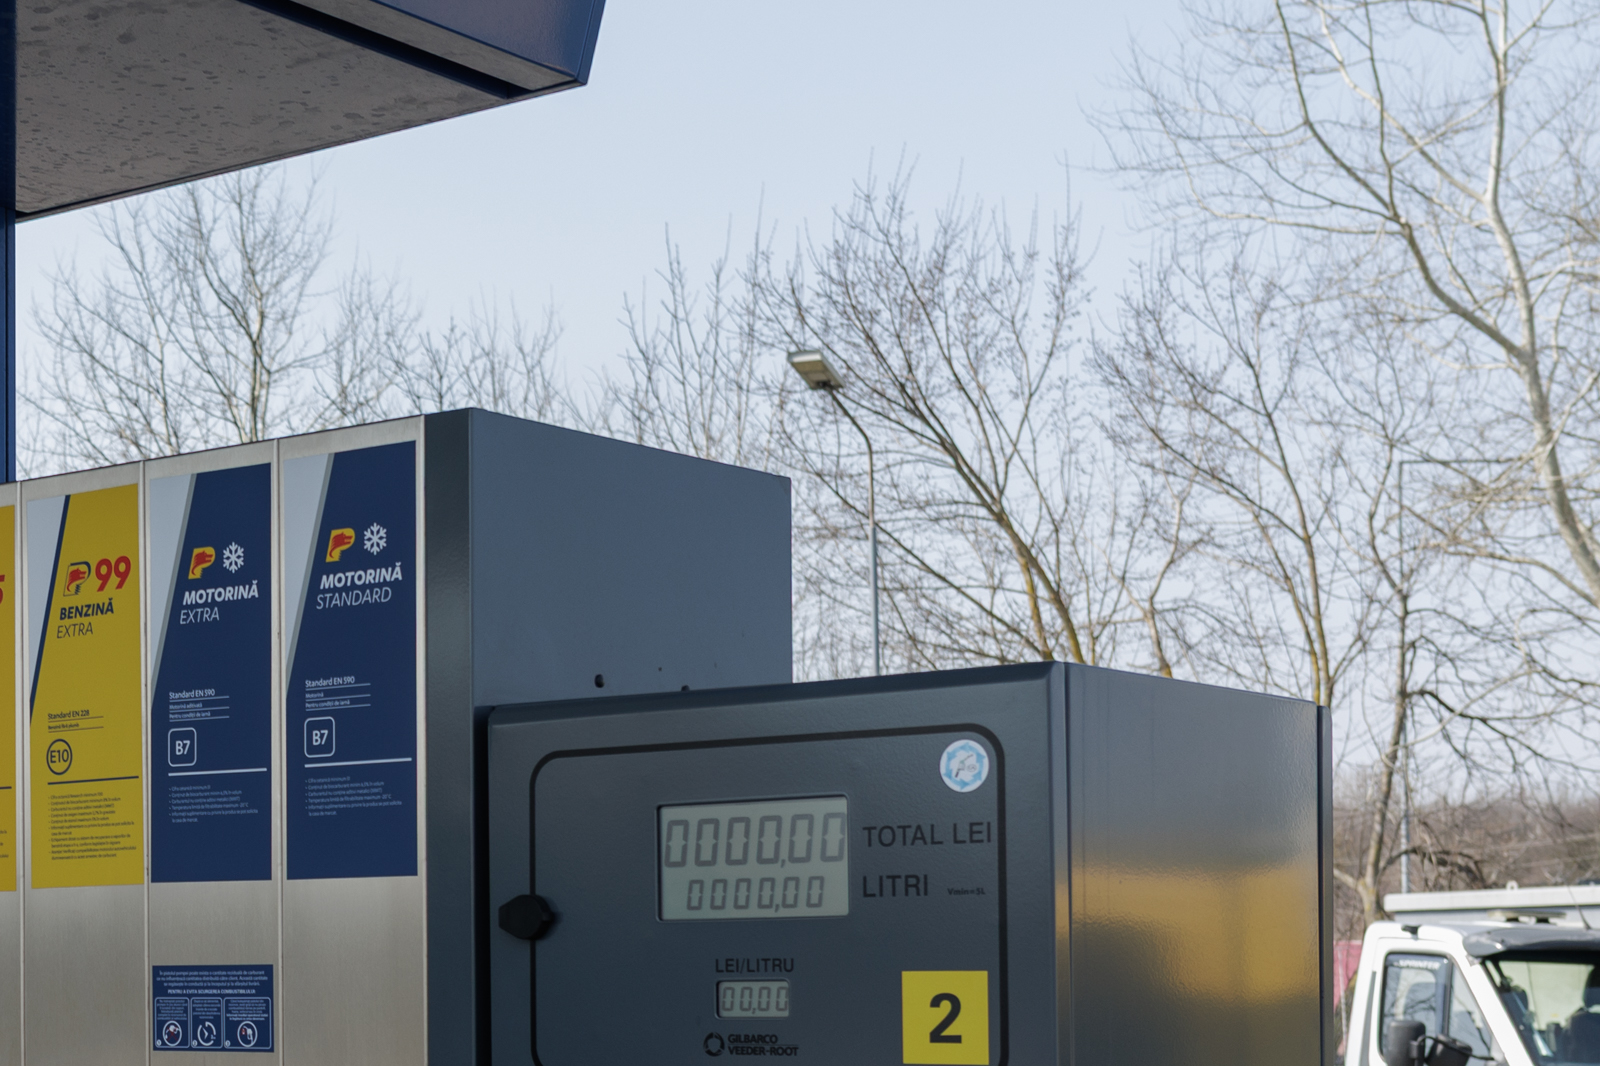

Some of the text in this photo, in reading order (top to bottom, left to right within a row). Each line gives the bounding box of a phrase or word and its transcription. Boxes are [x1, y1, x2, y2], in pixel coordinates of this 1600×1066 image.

[320, 562, 402, 590] MOTORINĂ
[182, 580, 259, 606] MOTORINĂ
[316, 587, 392, 610] STANDARD
[60, 598, 114, 620] BENZINĂ
[180, 607, 220, 624] EXTRA
[56, 622, 93, 638] EXTRA
[306, 677, 332, 688] Standard
[334, 677, 342, 685] EN
[169, 690, 194, 699] Standard
[196, 689, 204, 697] EN
[312, 730, 328, 746] B7
[176, 740, 190, 755] B7
[50, 748, 70, 764] E10
[862, 822, 990, 847] TOTAL LEI
[862, 874, 928, 897] LITRI
[716, 958, 794, 974] LEI/LITRU
[928, 992, 963, 1044] 2
[728, 1034, 778, 1044] GILBARCO
[728, 1046, 798, 1056] VEEDER-ROOT
